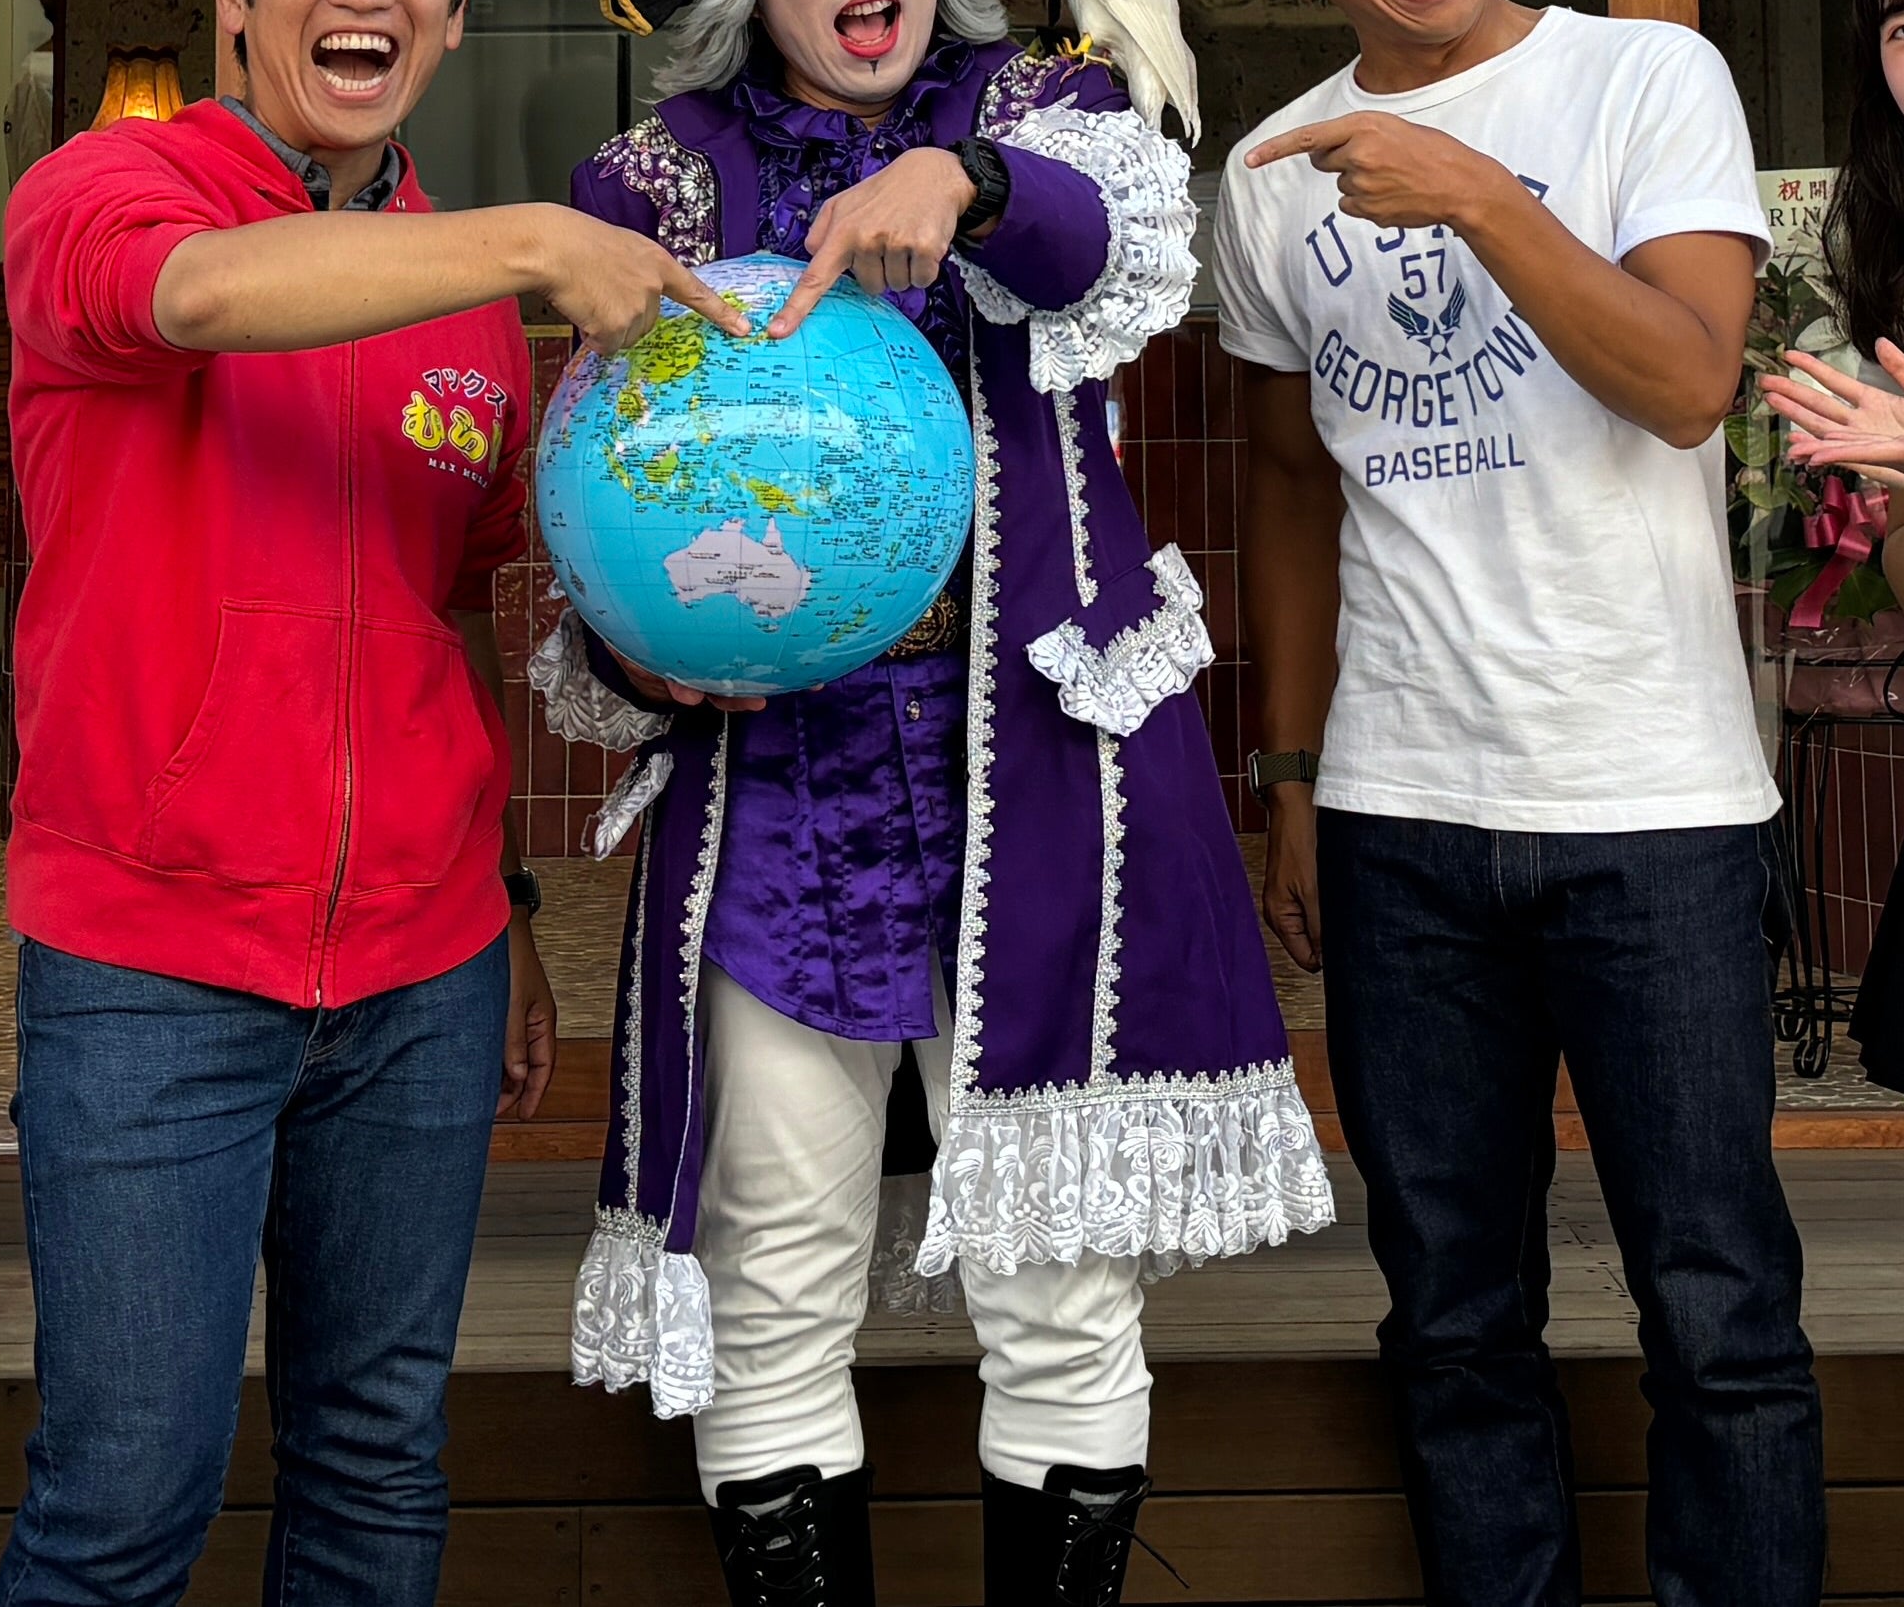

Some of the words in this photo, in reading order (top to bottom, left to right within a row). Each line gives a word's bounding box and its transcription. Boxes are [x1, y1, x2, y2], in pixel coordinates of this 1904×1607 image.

[1400, 249, 1445, 300] 57
[423, 368, 507, 418] マックス
[1314, 308, 1538, 428] GEORGETOW
[1365, 433, 1526, 488] BASEBALL
